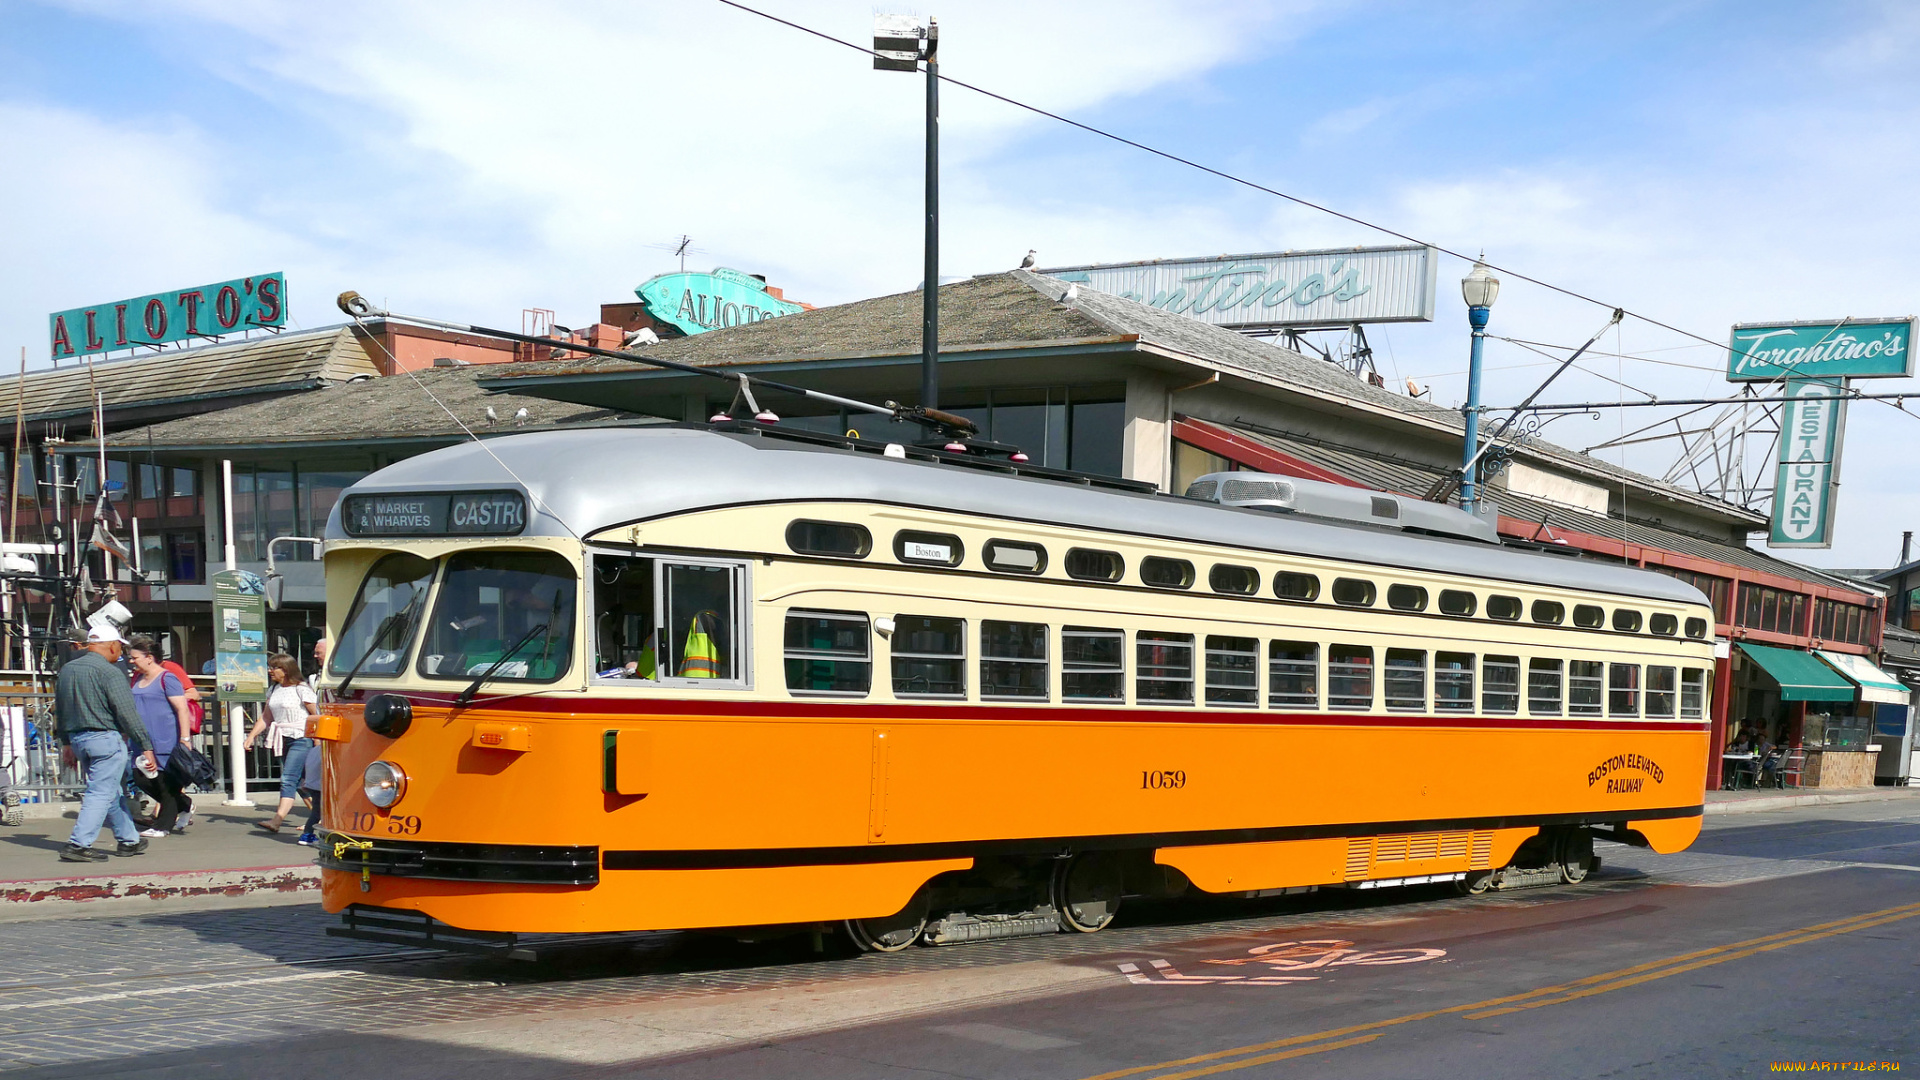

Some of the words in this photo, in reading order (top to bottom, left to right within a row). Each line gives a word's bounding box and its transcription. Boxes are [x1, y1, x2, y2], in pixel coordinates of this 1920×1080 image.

[1056, 258, 1372, 314] ntino's
[52, 278, 281, 356] ALIOTO'S
[1735, 329, 1905, 374] Tarantino's
[1790, 392, 1823, 533] RESTAURANT
[361, 517, 369, 526] &
[374, 516, 431, 526] WHARVES
[365, 504, 372, 513] F
[377, 503, 424, 513] MARKET
[915, 545, 941, 558] Boston
[1140, 770, 1186, 789] 1059
[1588, 754, 1626, 788] BOSTON
[1627, 753, 1664, 784] ELEVATED
[1606, 778, 1644, 793] RAILWAY
